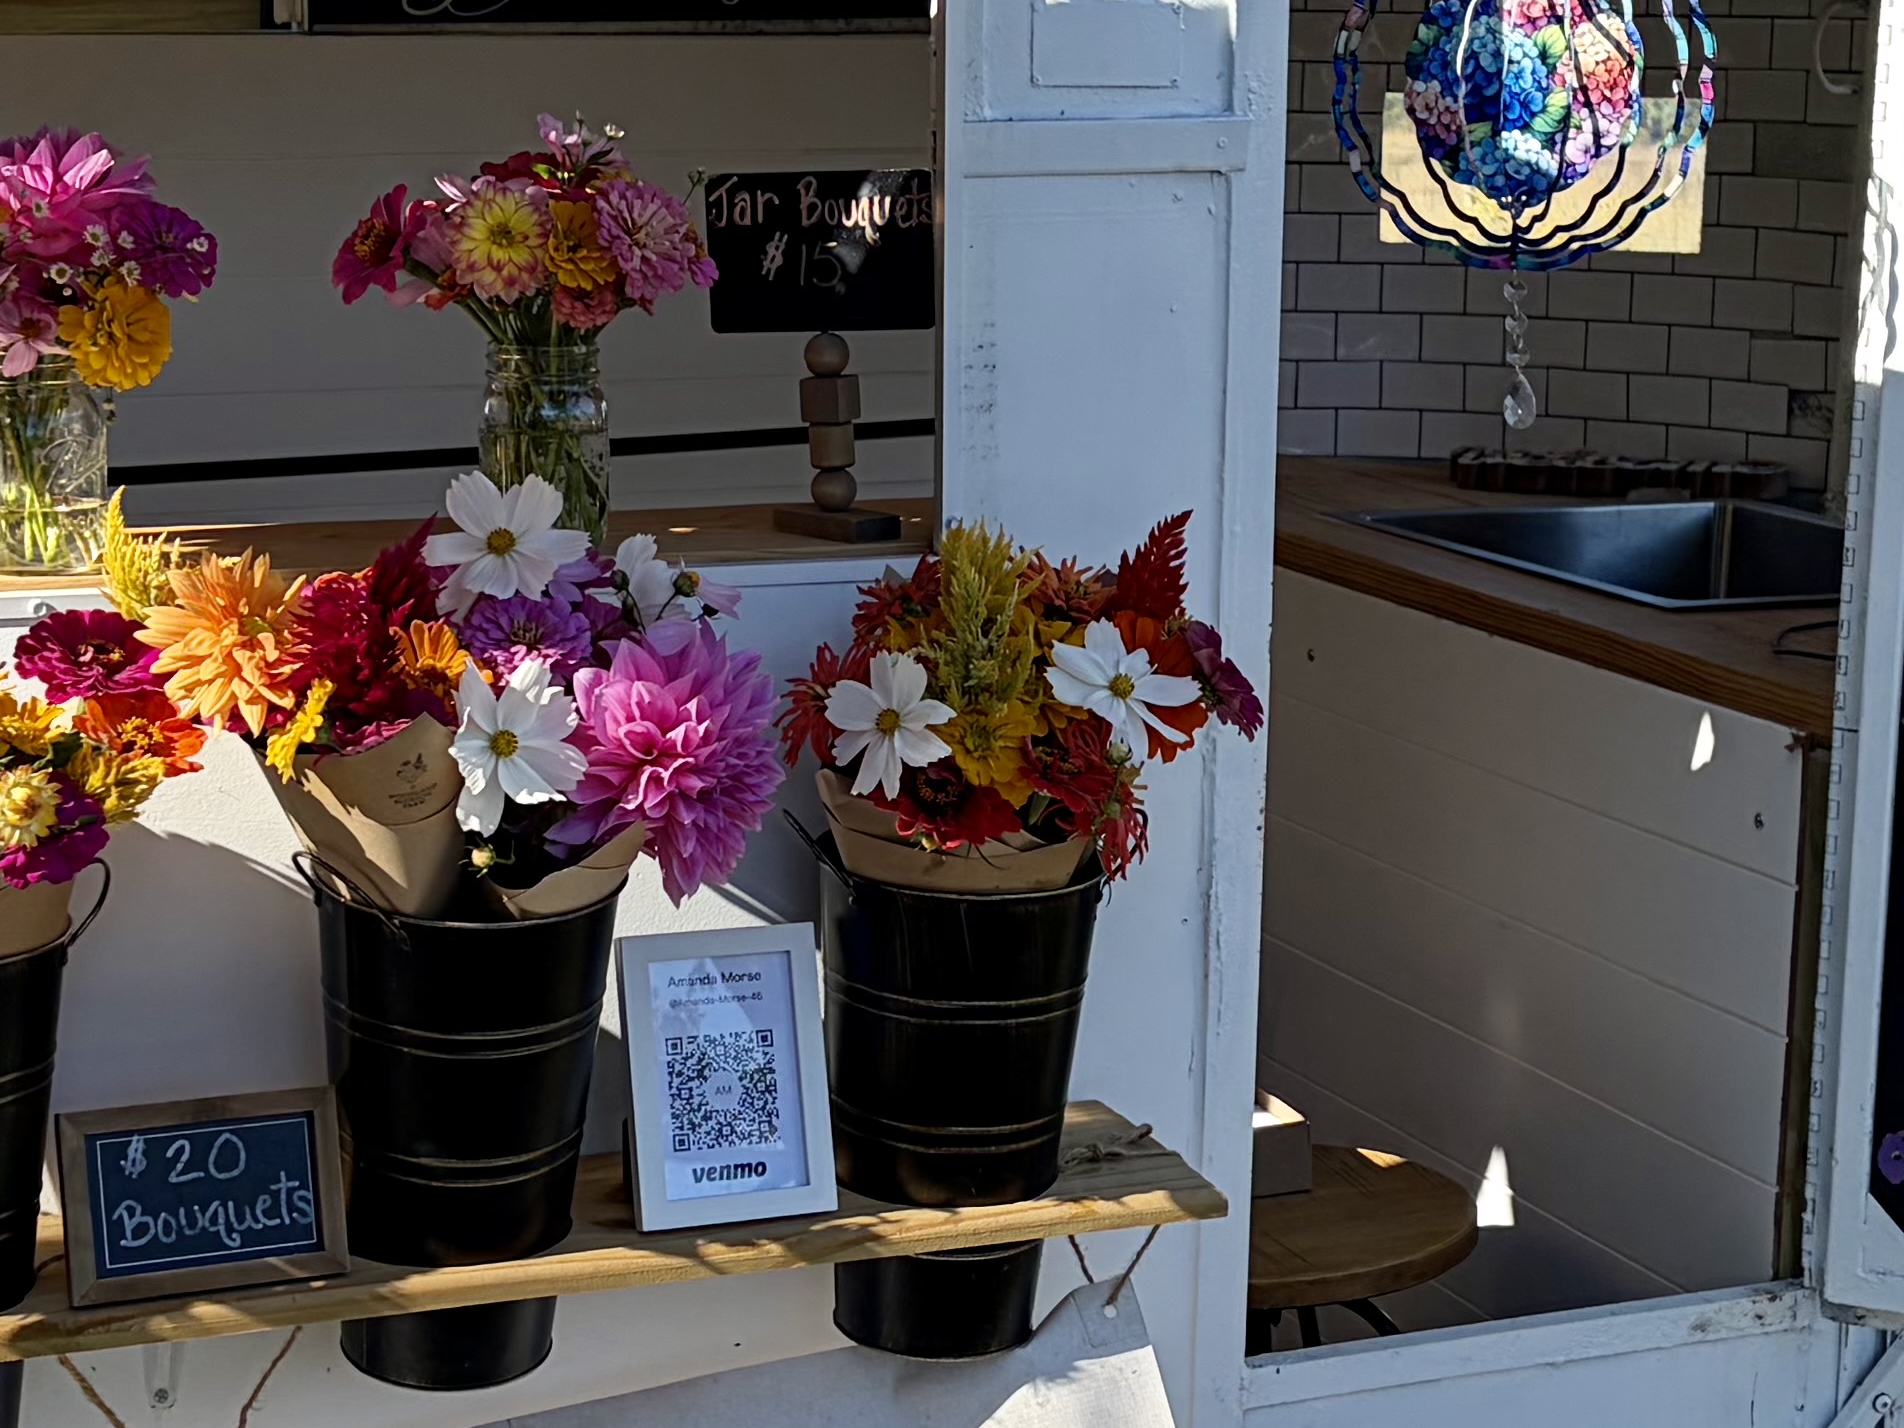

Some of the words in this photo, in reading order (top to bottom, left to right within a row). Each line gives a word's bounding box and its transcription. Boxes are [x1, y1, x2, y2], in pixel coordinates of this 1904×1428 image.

[709, 176, 780, 228] Jar
[796, 175, 933, 248] Bouquets
[667, 973, 718, 988] Amanda
[720, 971, 762, 984] Morse
[691, 1161, 768, 1184] venmo
[112, 1170, 315, 1249] Bouquets
